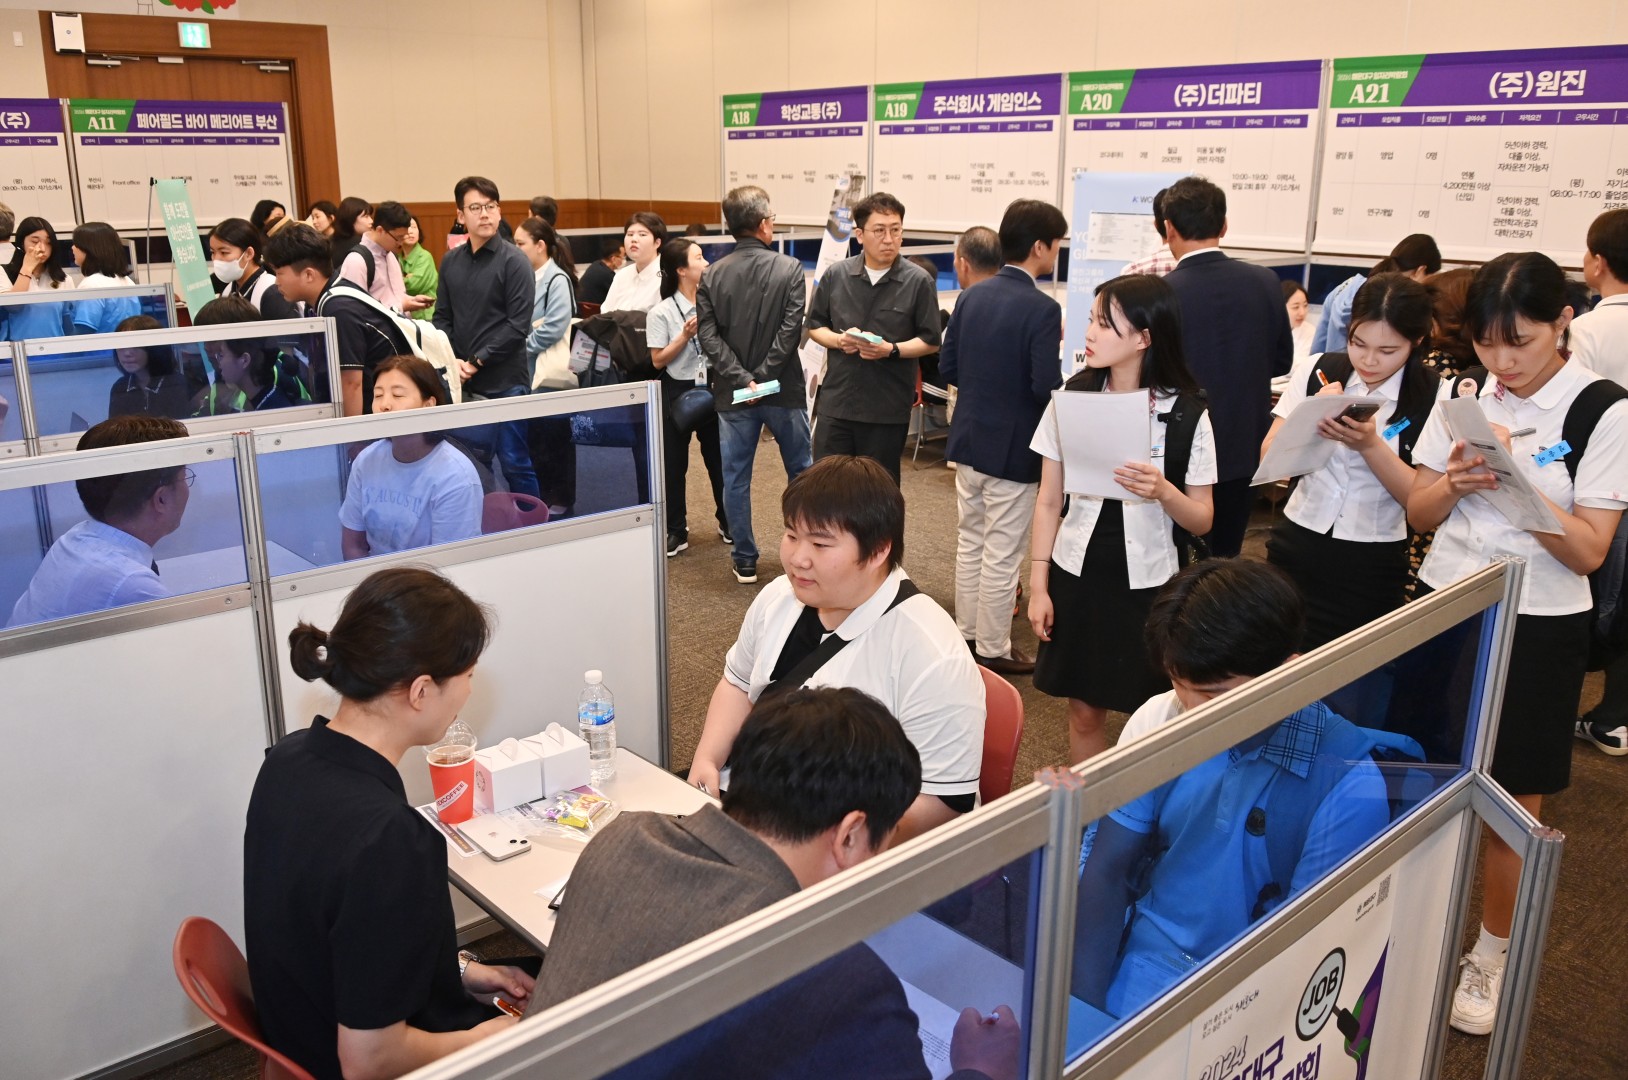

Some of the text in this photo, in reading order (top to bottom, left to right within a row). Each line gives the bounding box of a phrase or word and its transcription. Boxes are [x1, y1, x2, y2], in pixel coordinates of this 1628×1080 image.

[1489, 69, 1587, 98] (주)원진
[1081, 93, 1113, 111] A20
[1174, 82, 1262, 108] (주)더파티
[1349, 83, 1390, 104] A21
[884, 102, 908, 118] A19
[933, 94, 985, 115] 주식회사
[986, 91, 1042, 113] 게임인스
[0, 112, 31, 129] (주)
[88, 116, 116, 131] A11
[136, 113, 278, 130] 페어필드 바이 메리어트 부산
[731, 111, 750, 124] A18
[1302, 966, 1340, 1015] JOB
